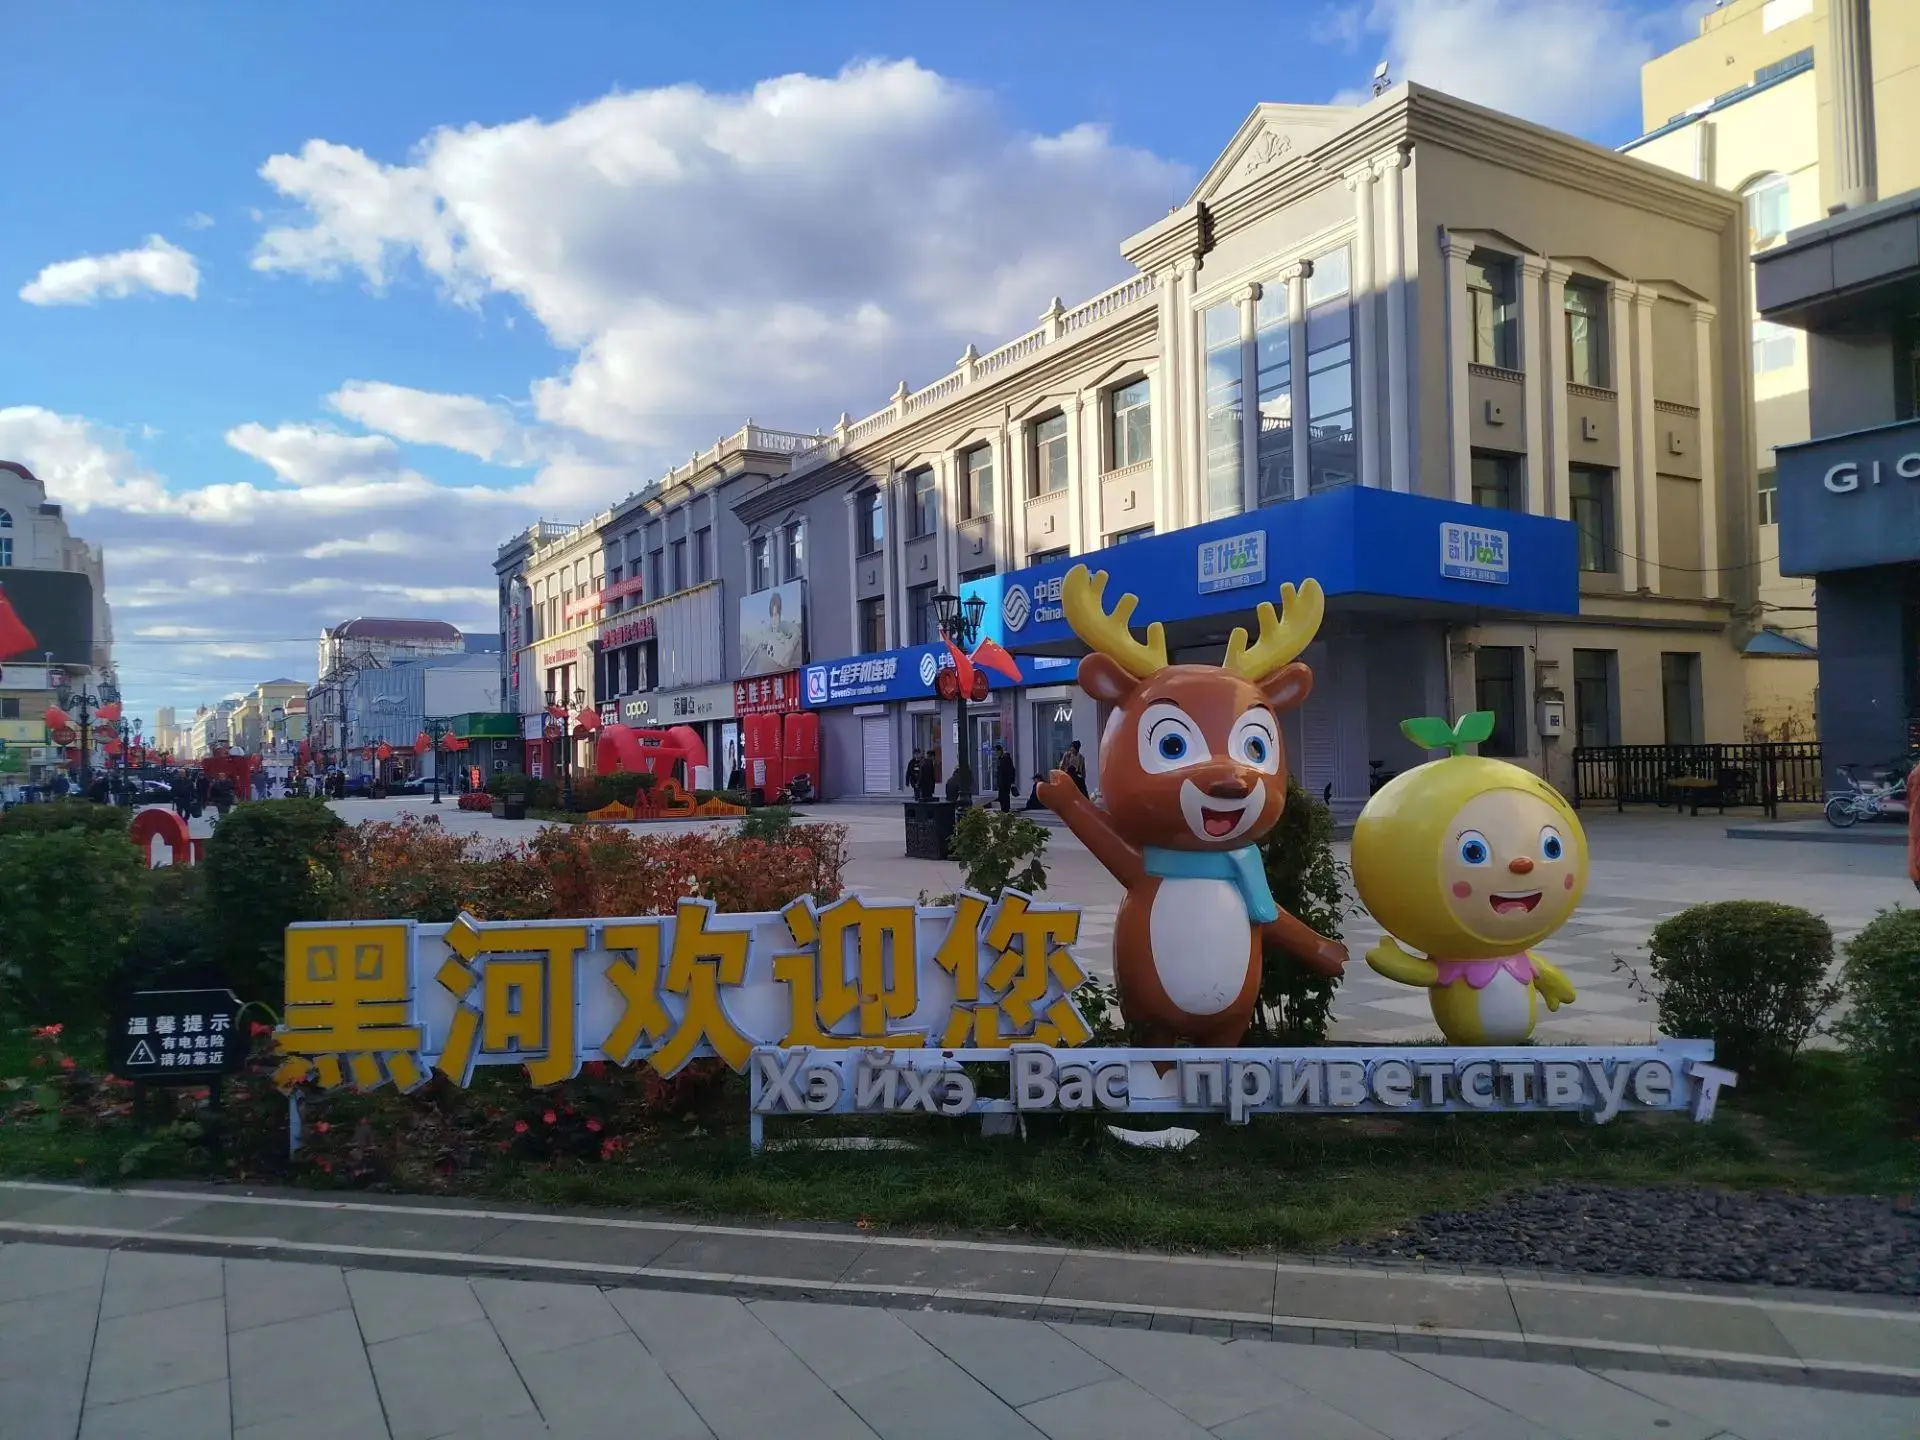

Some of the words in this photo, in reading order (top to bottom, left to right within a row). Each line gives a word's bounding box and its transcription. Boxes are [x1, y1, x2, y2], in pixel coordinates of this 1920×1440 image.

[1217, 537, 1258, 573] 优选
[1463, 531, 1504, 566] 优选
[1034, 607, 1063, 622] China
[830, 657, 898, 687] 七星手机连锁
[271, 889, 1092, 1094] 黑河欢迎您
[127, 1013, 230, 1035] 温馨提示
[161, 1034, 225, 1050] 有电危险
[160, 1051, 224, 1067] 请勿靠近
[1011, 1044, 1130, 1111] Вас
[1179, 1056, 1738, 1126] приветствует
